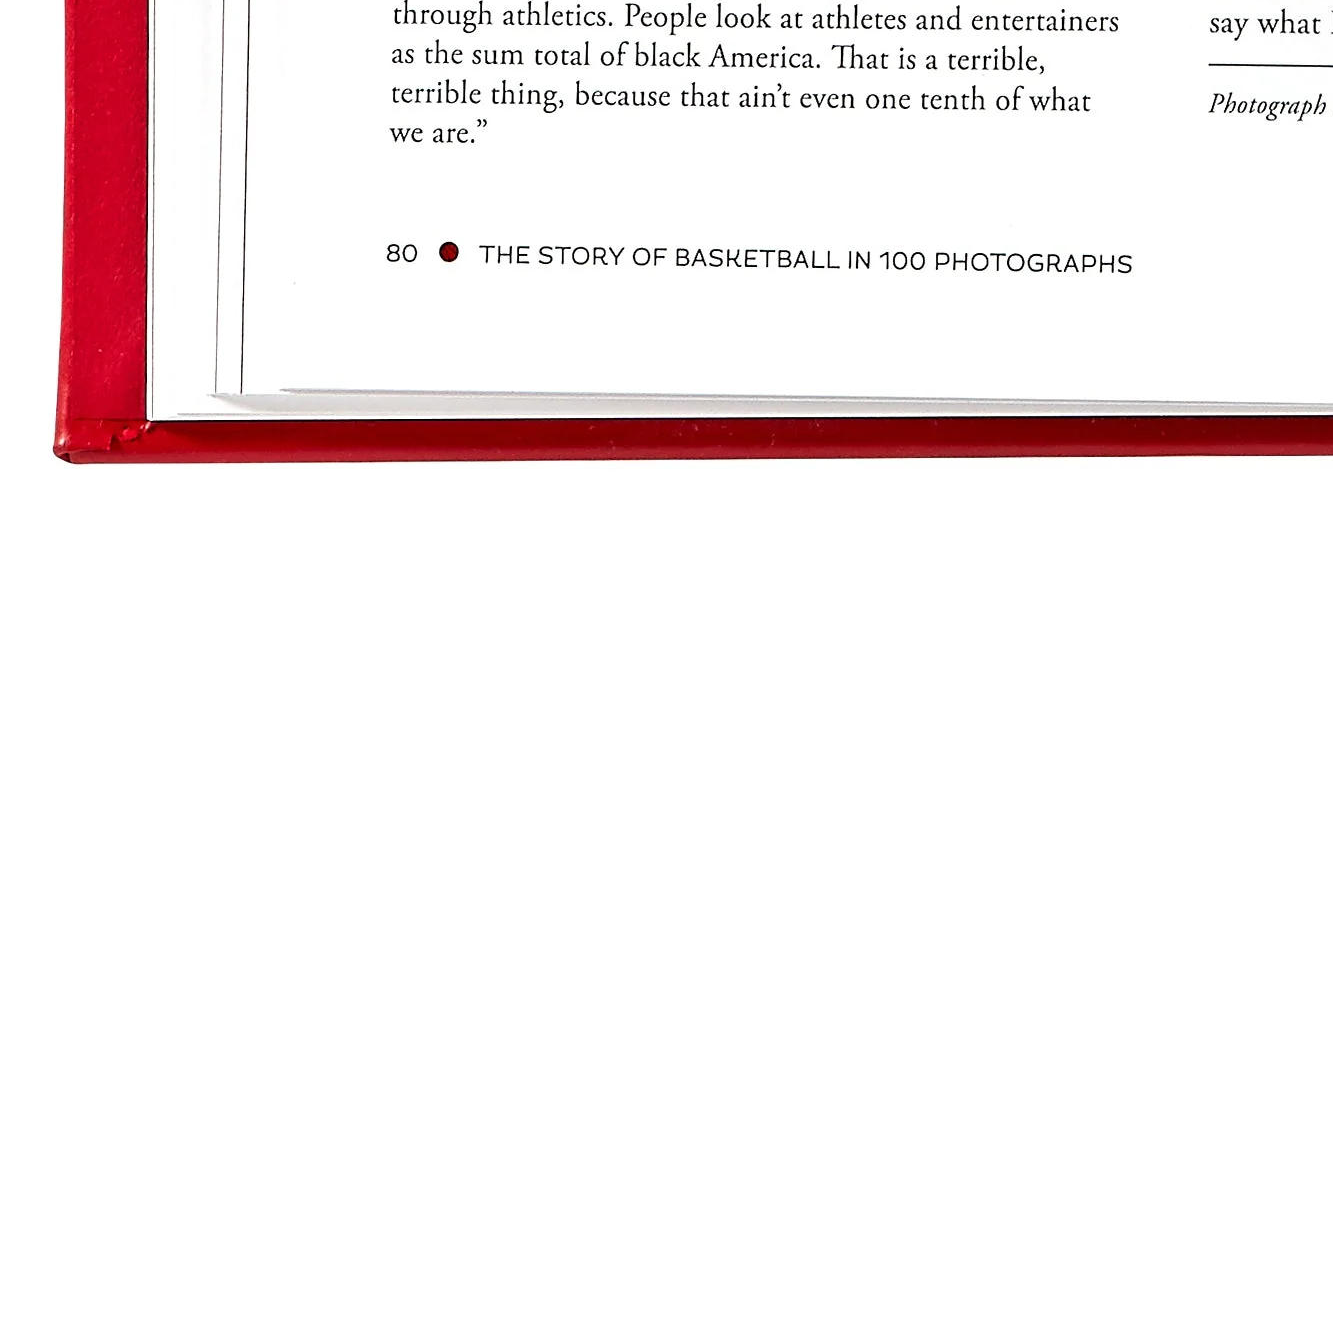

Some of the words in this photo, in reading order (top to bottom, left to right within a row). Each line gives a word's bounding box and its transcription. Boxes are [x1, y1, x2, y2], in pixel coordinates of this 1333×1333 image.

[393, 0, 493, 34] through
[502, 0, 613, 27] athletics.
[624, 2, 707, 36] People
[715, 2, 772, 29] look
[780, 11, 804, 29] at
[811, 3, 907, 31] athletes
[915, 4, 963, 31] and
[971, 8, 1119, 33] entertainers
[1208, 91, 1327, 122] Photograph
[386, 243, 418, 263] 80
[478, 244, 531, 265] THE
[538, 245, 625, 266] STORY
[632, 246, 668, 267] OF
[675, 247, 841, 270] BASKETBALL
[848, 250, 871, 270] IN
[879, 251, 926, 271] 100
[935, 251, 1133, 274] PHOTOGRAPHS
